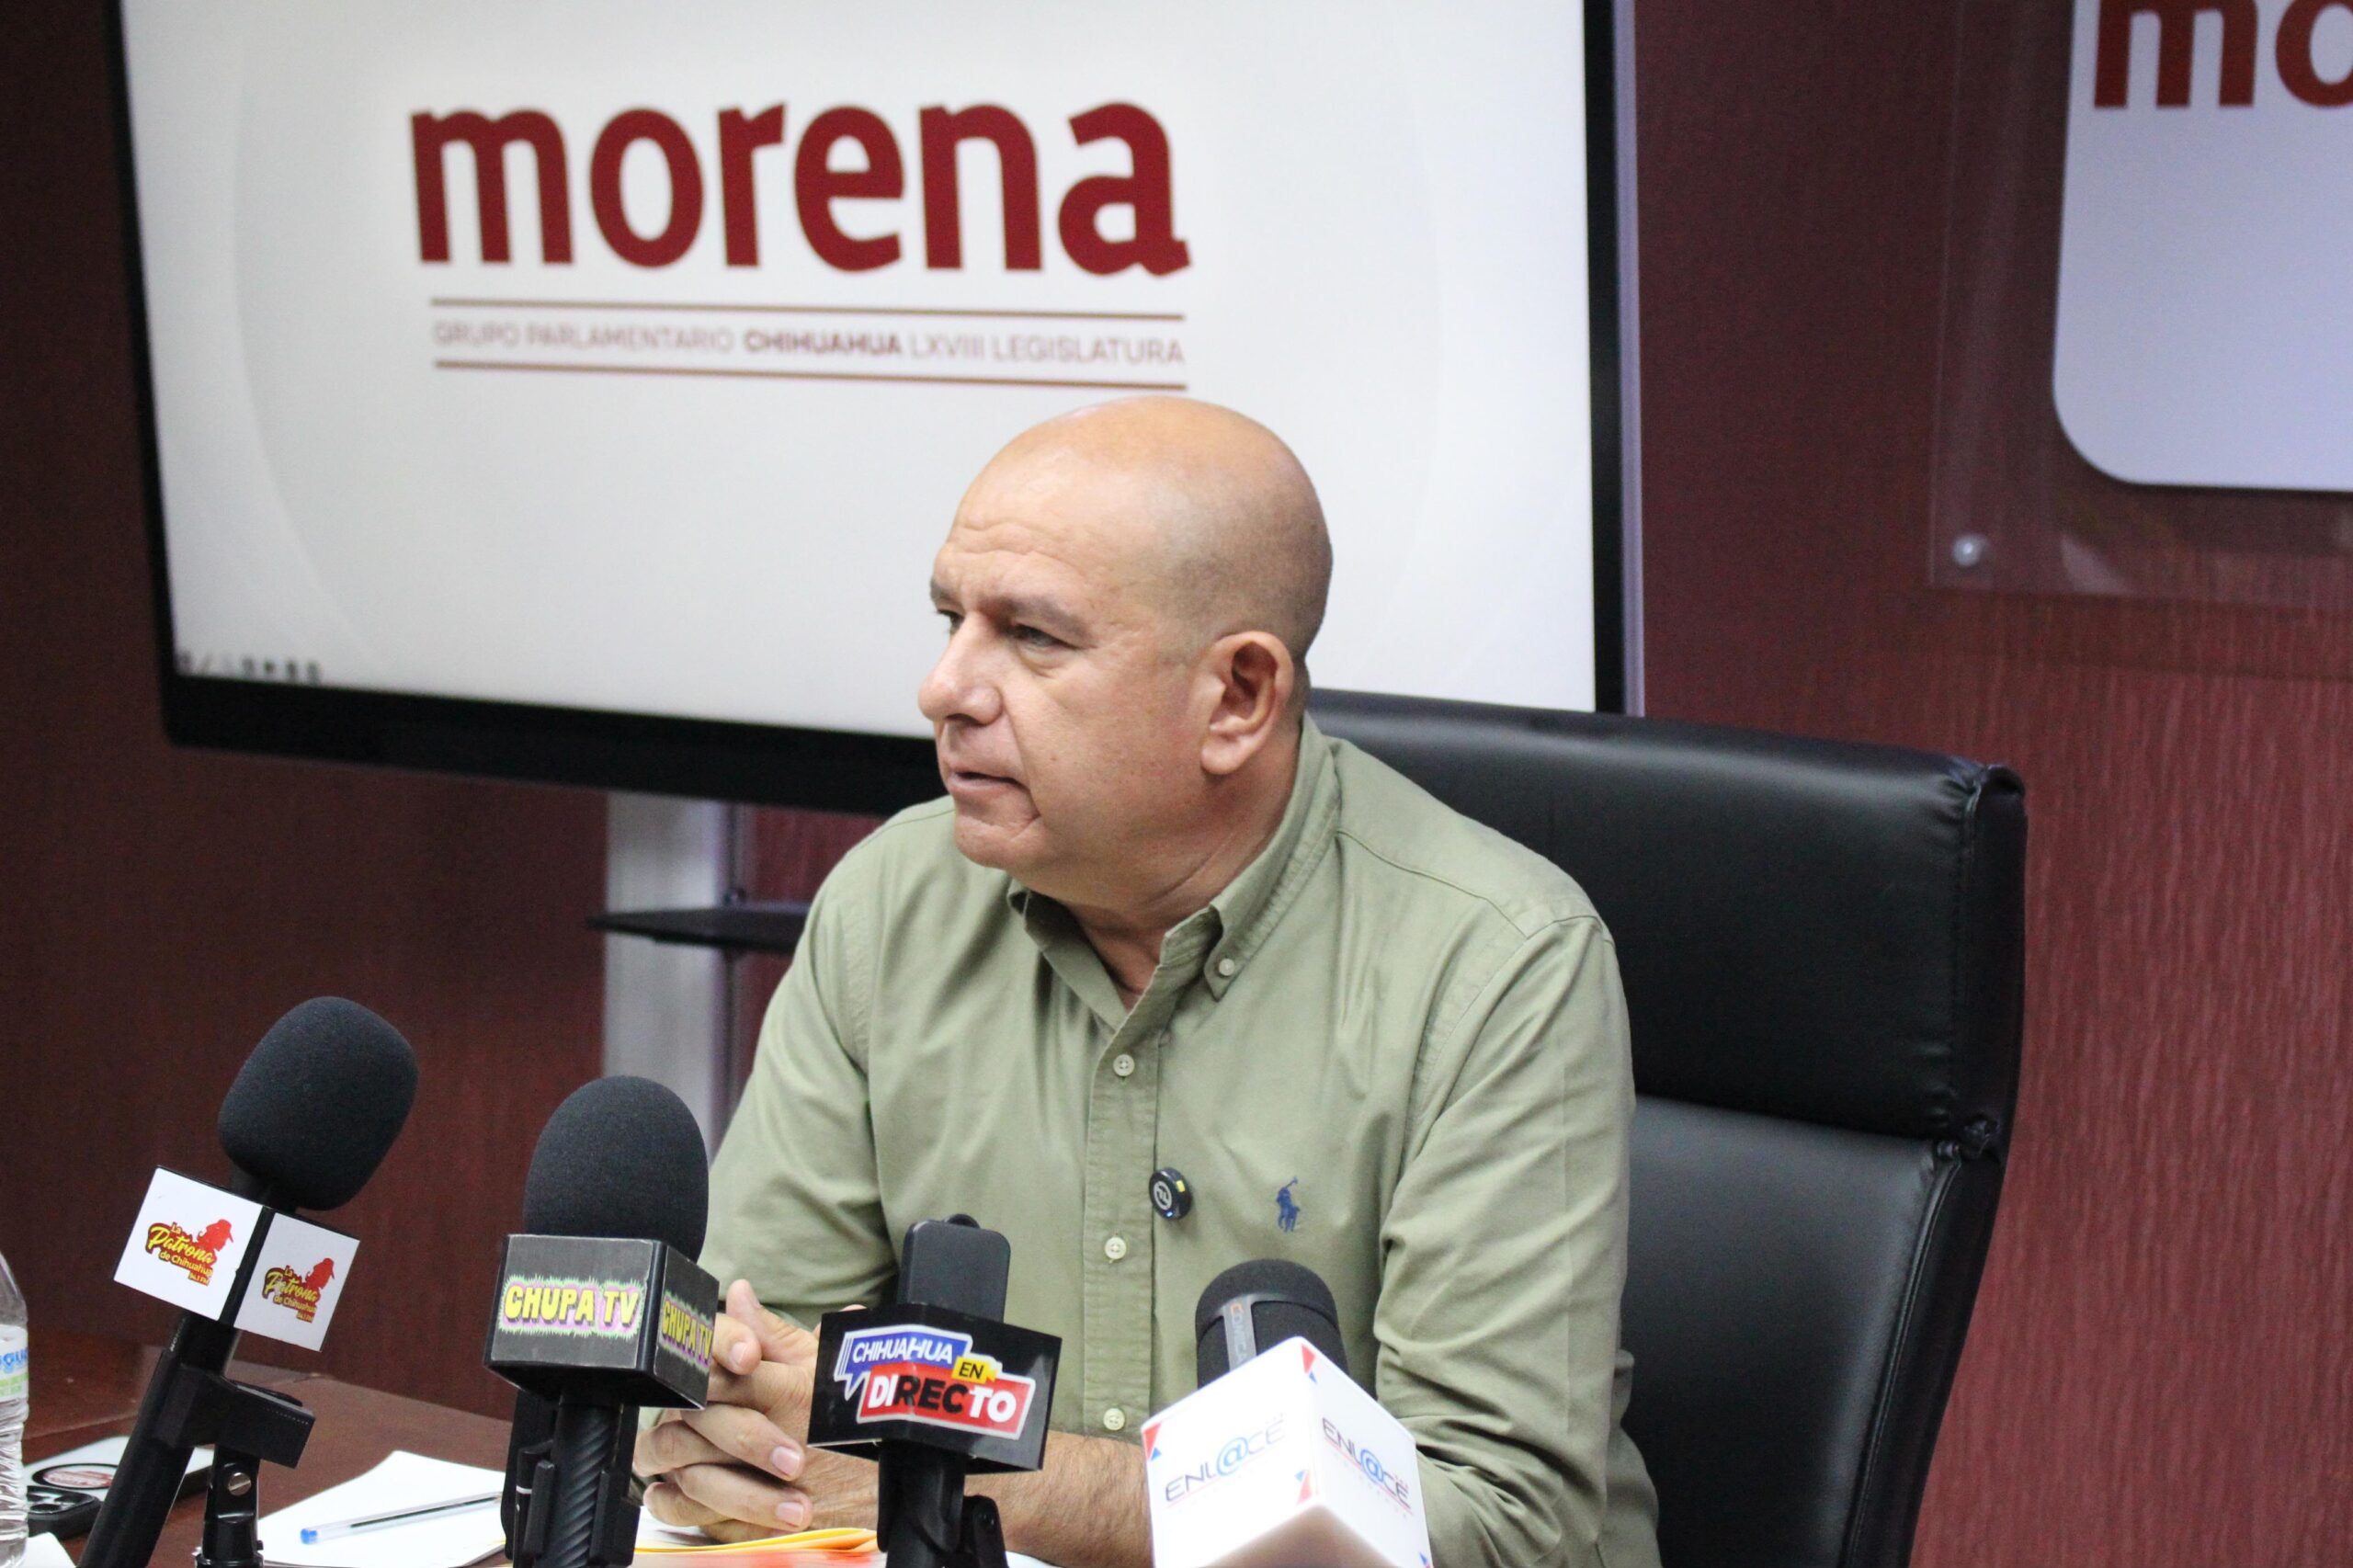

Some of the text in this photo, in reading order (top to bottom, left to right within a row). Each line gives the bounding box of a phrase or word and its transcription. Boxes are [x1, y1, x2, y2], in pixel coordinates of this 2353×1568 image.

[411, 102, 1191, 277] morena
[434, 321, 1186, 366] GRUPO PARLAMENTARIO CHIHUAHUA LXVIII LEGISLATURA
[147, 1225, 214, 1264] Patrona
[171, 1222, 183, 1235] La
[159, 1250, 213, 1278] de Chihuahua
[506, 1285, 639, 1326] CHUPA TV
[663, 1301, 713, 1365] CHUPA TV
[853, 1336, 984, 1380] CHIHUAHUA EN
[868, 1373, 1017, 1423] DIRECTO
[1165, 1418, 1286, 1502] ENL@CE
[1322, 1416, 1411, 1509] ENL@CE
